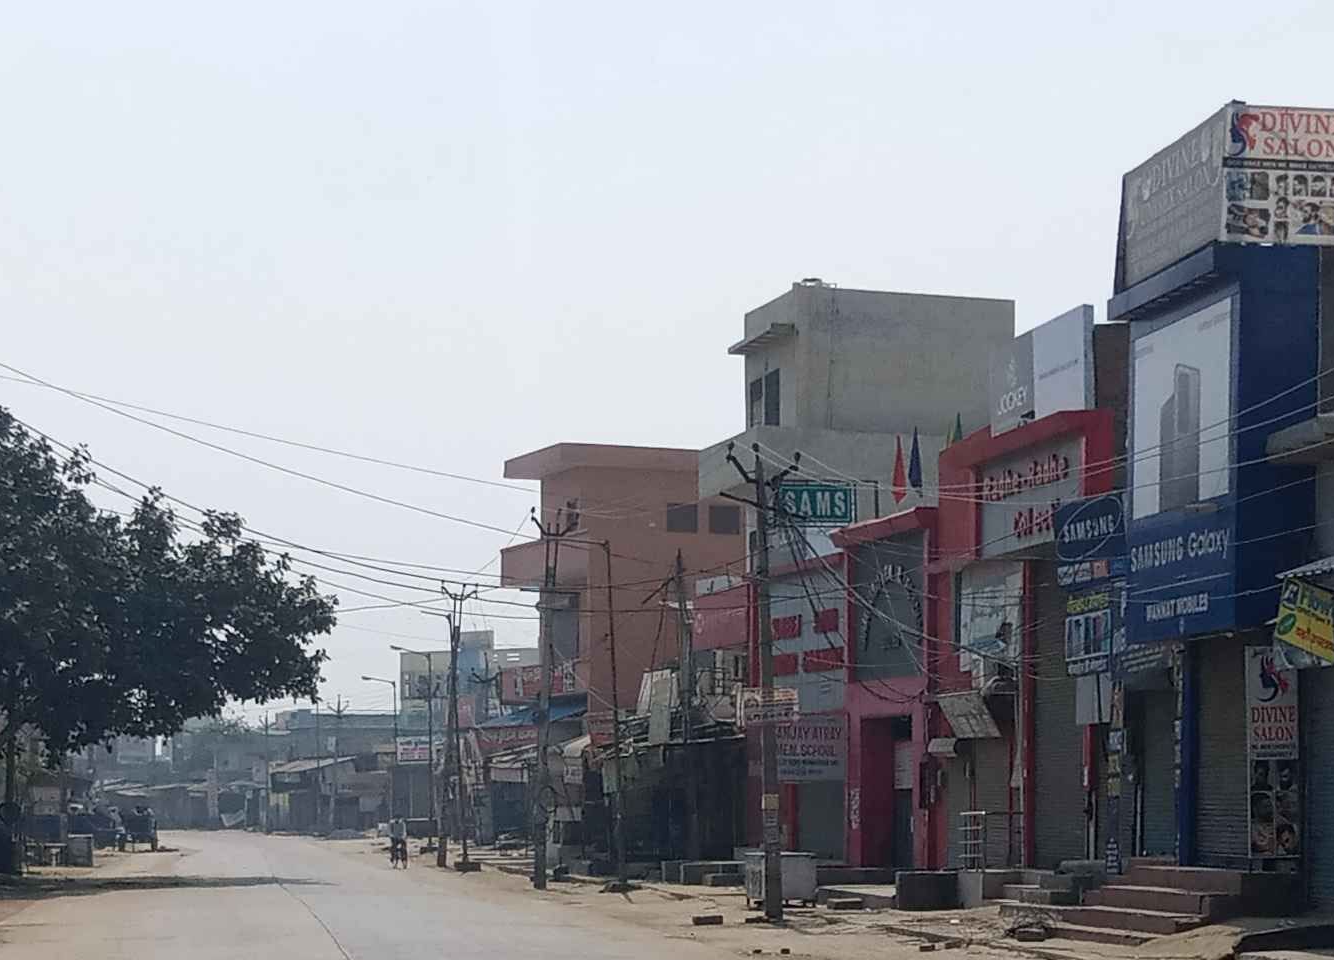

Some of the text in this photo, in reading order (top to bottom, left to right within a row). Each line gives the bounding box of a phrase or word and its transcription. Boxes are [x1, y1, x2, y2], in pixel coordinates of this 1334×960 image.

[784, 490, 847, 517] SAMS
[1063, 513, 1115, 543] SAMSUNG
[1130, 536, 1184, 573] SAMSUNG
[1187, 527, 1230, 560] Galaxy
[1253, 726, 1294, 741] SALON
